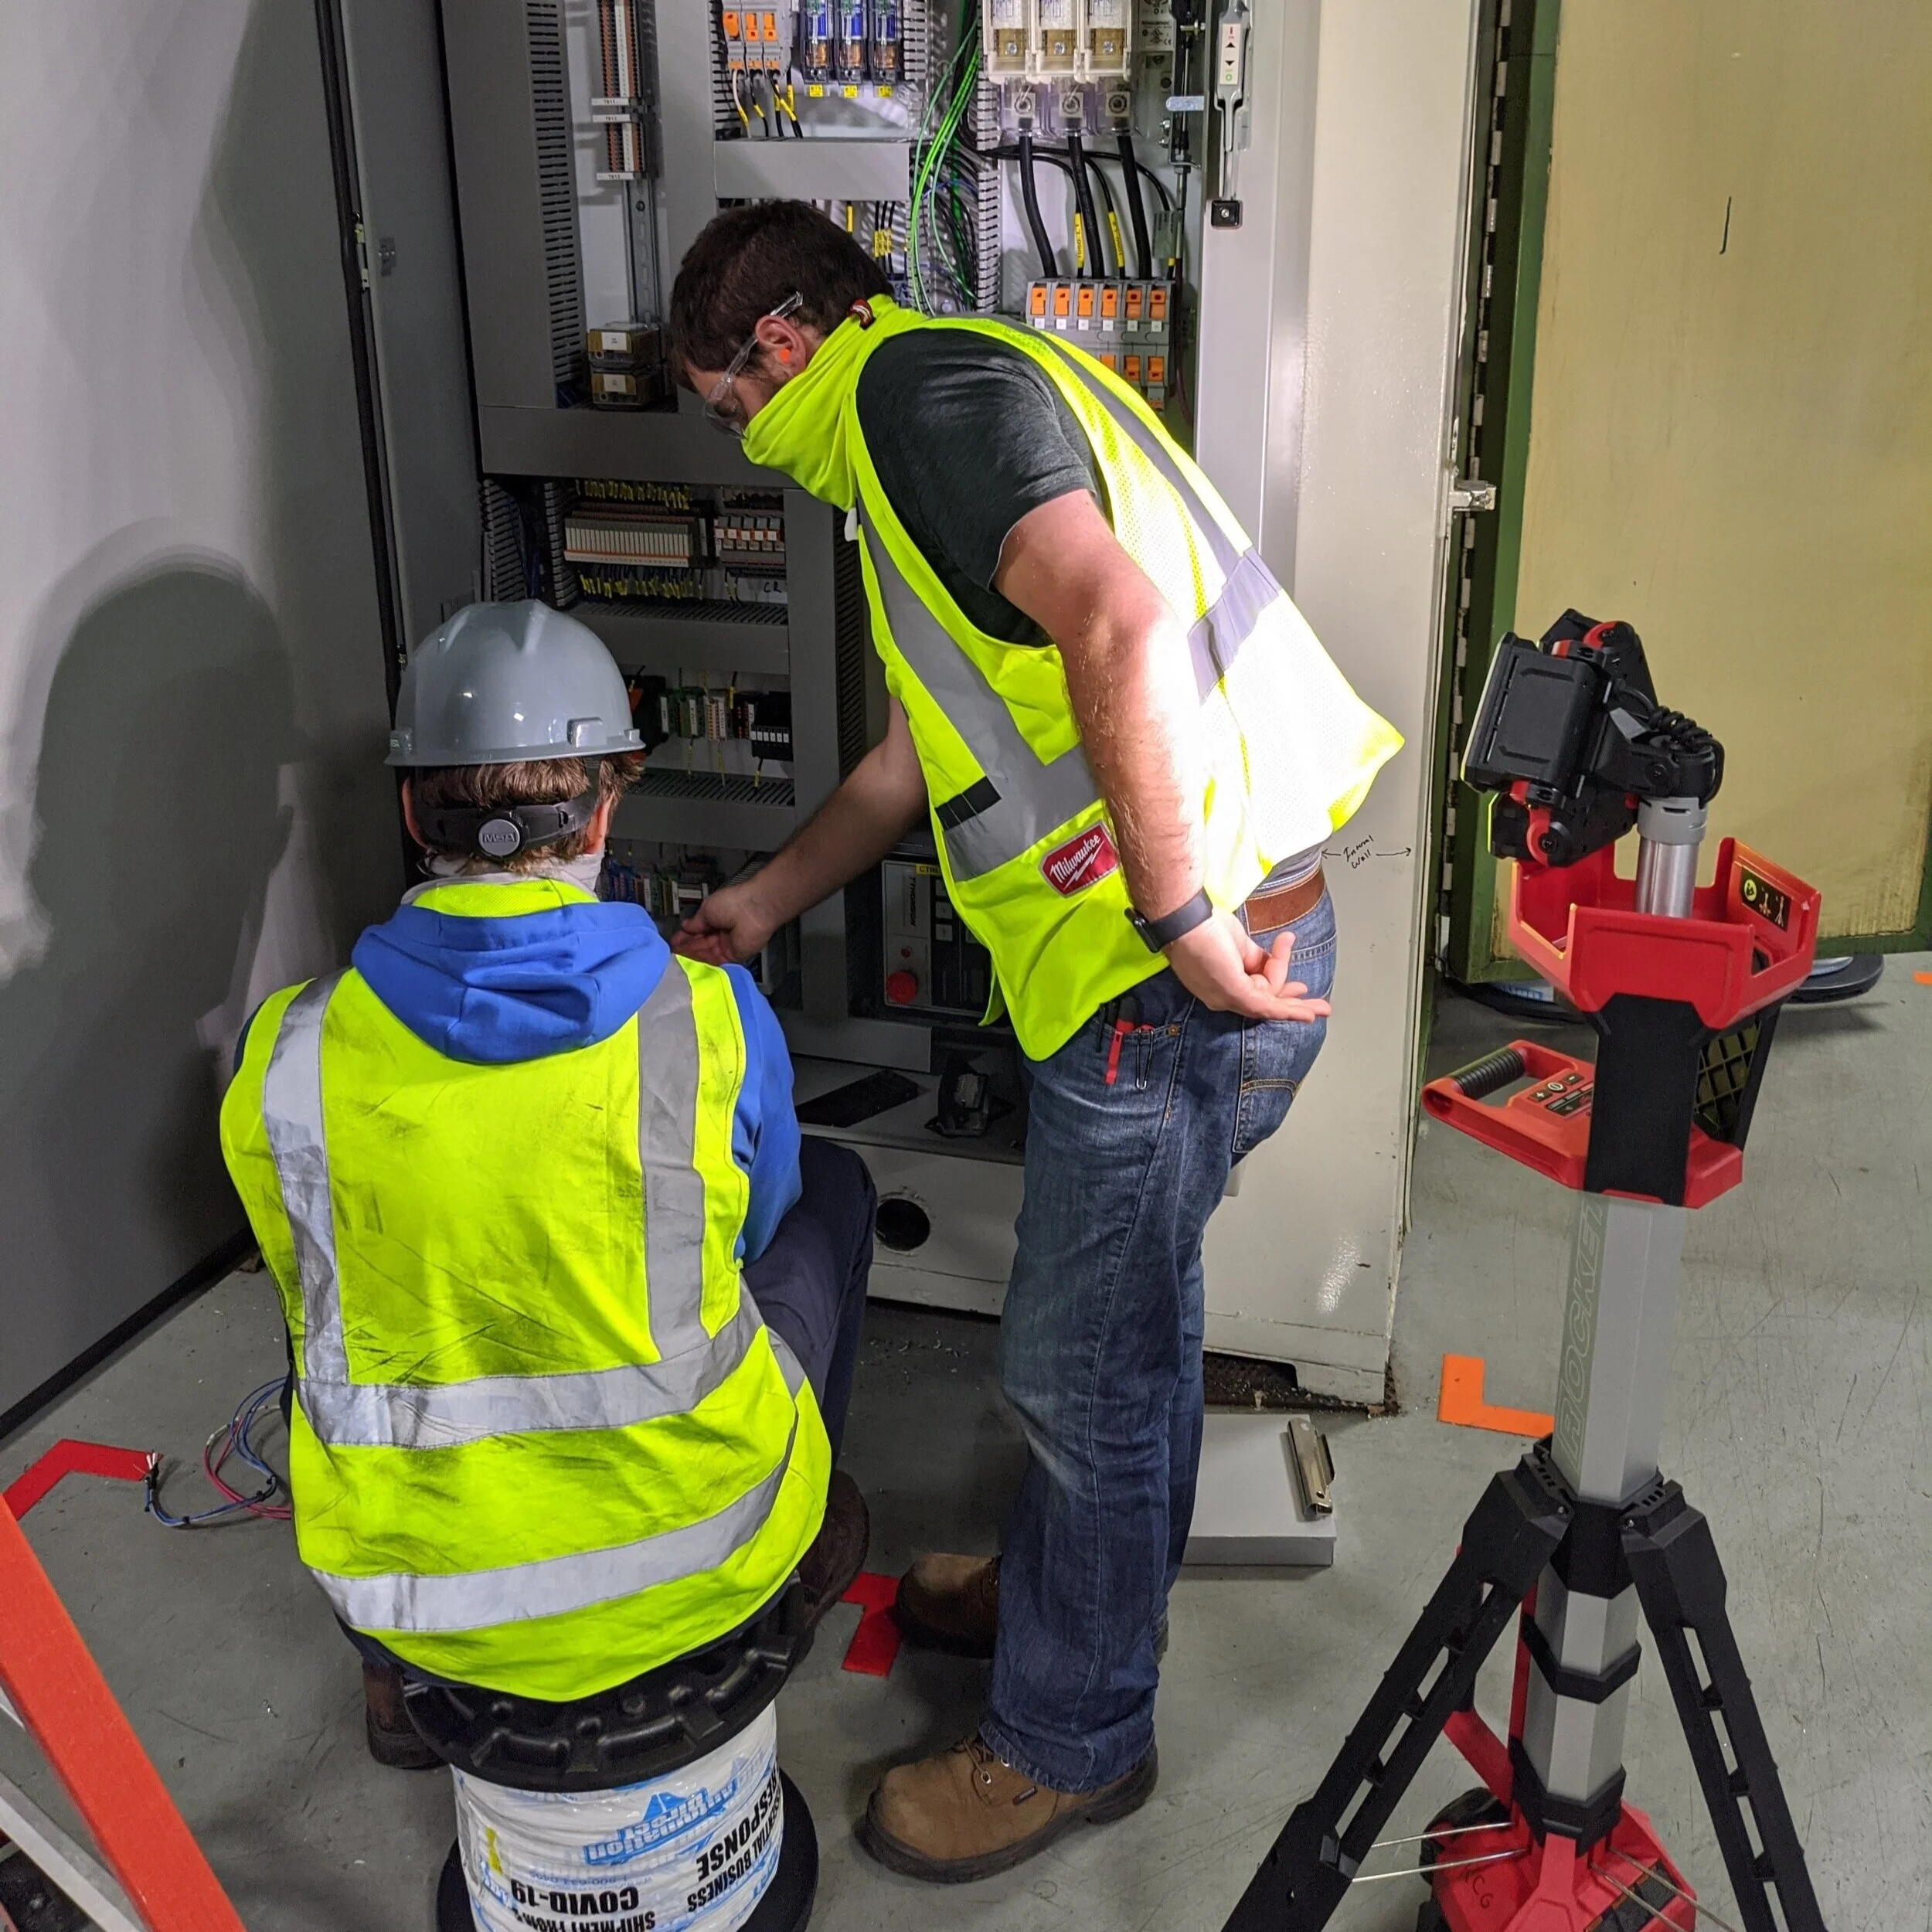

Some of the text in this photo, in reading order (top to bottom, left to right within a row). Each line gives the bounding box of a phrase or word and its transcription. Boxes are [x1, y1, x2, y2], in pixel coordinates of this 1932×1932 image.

[763, 580, 782, 594] CR
[482, 832, 517, 844] MSA
[1049, 835, 1101, 884] Milwaukee
[1553, 1196, 1604, 1473] ROCKET
[696, 1764, 777, 1882] RESPONSE
[511, 1879, 640, 1915] COVID-19
[687, 1856, 752, 1912] BUSINESS
